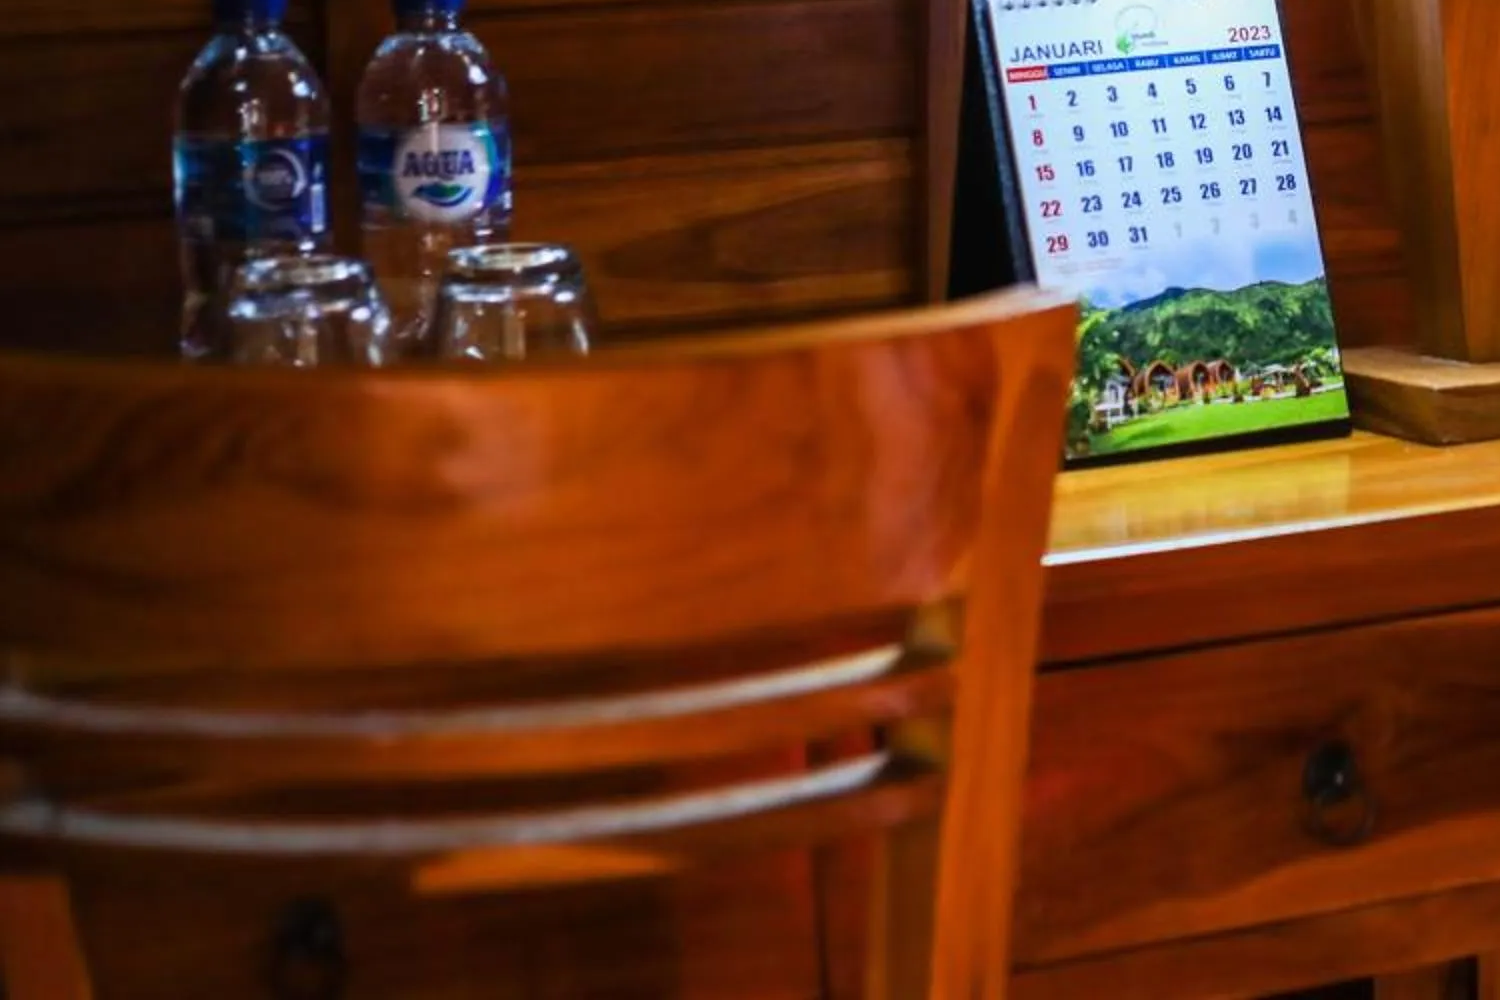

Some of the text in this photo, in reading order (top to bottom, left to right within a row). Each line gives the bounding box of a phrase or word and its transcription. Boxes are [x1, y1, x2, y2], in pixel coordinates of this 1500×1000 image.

[1229, 25, 1272, 43] 2023
[1010, 40, 1103, 63] JANUARI
[1173, 54, 1201, 66] KAMIS
[1028, 71, 1271, 111] 1 2 3 4 5 6 7
[1032, 105, 1283, 146] 8 9 10 11 12 13 14
[402, 149, 475, 181] AQUA
[1035, 140, 1289, 181] 15 16 17 18 19 20 21
[1040, 173, 1297, 218] 22 23 24 25 26 27 28
[1046, 235, 1069, 253] 29
[1087, 230, 1109, 248] 30
[1128, 226, 1148, 244] 31
